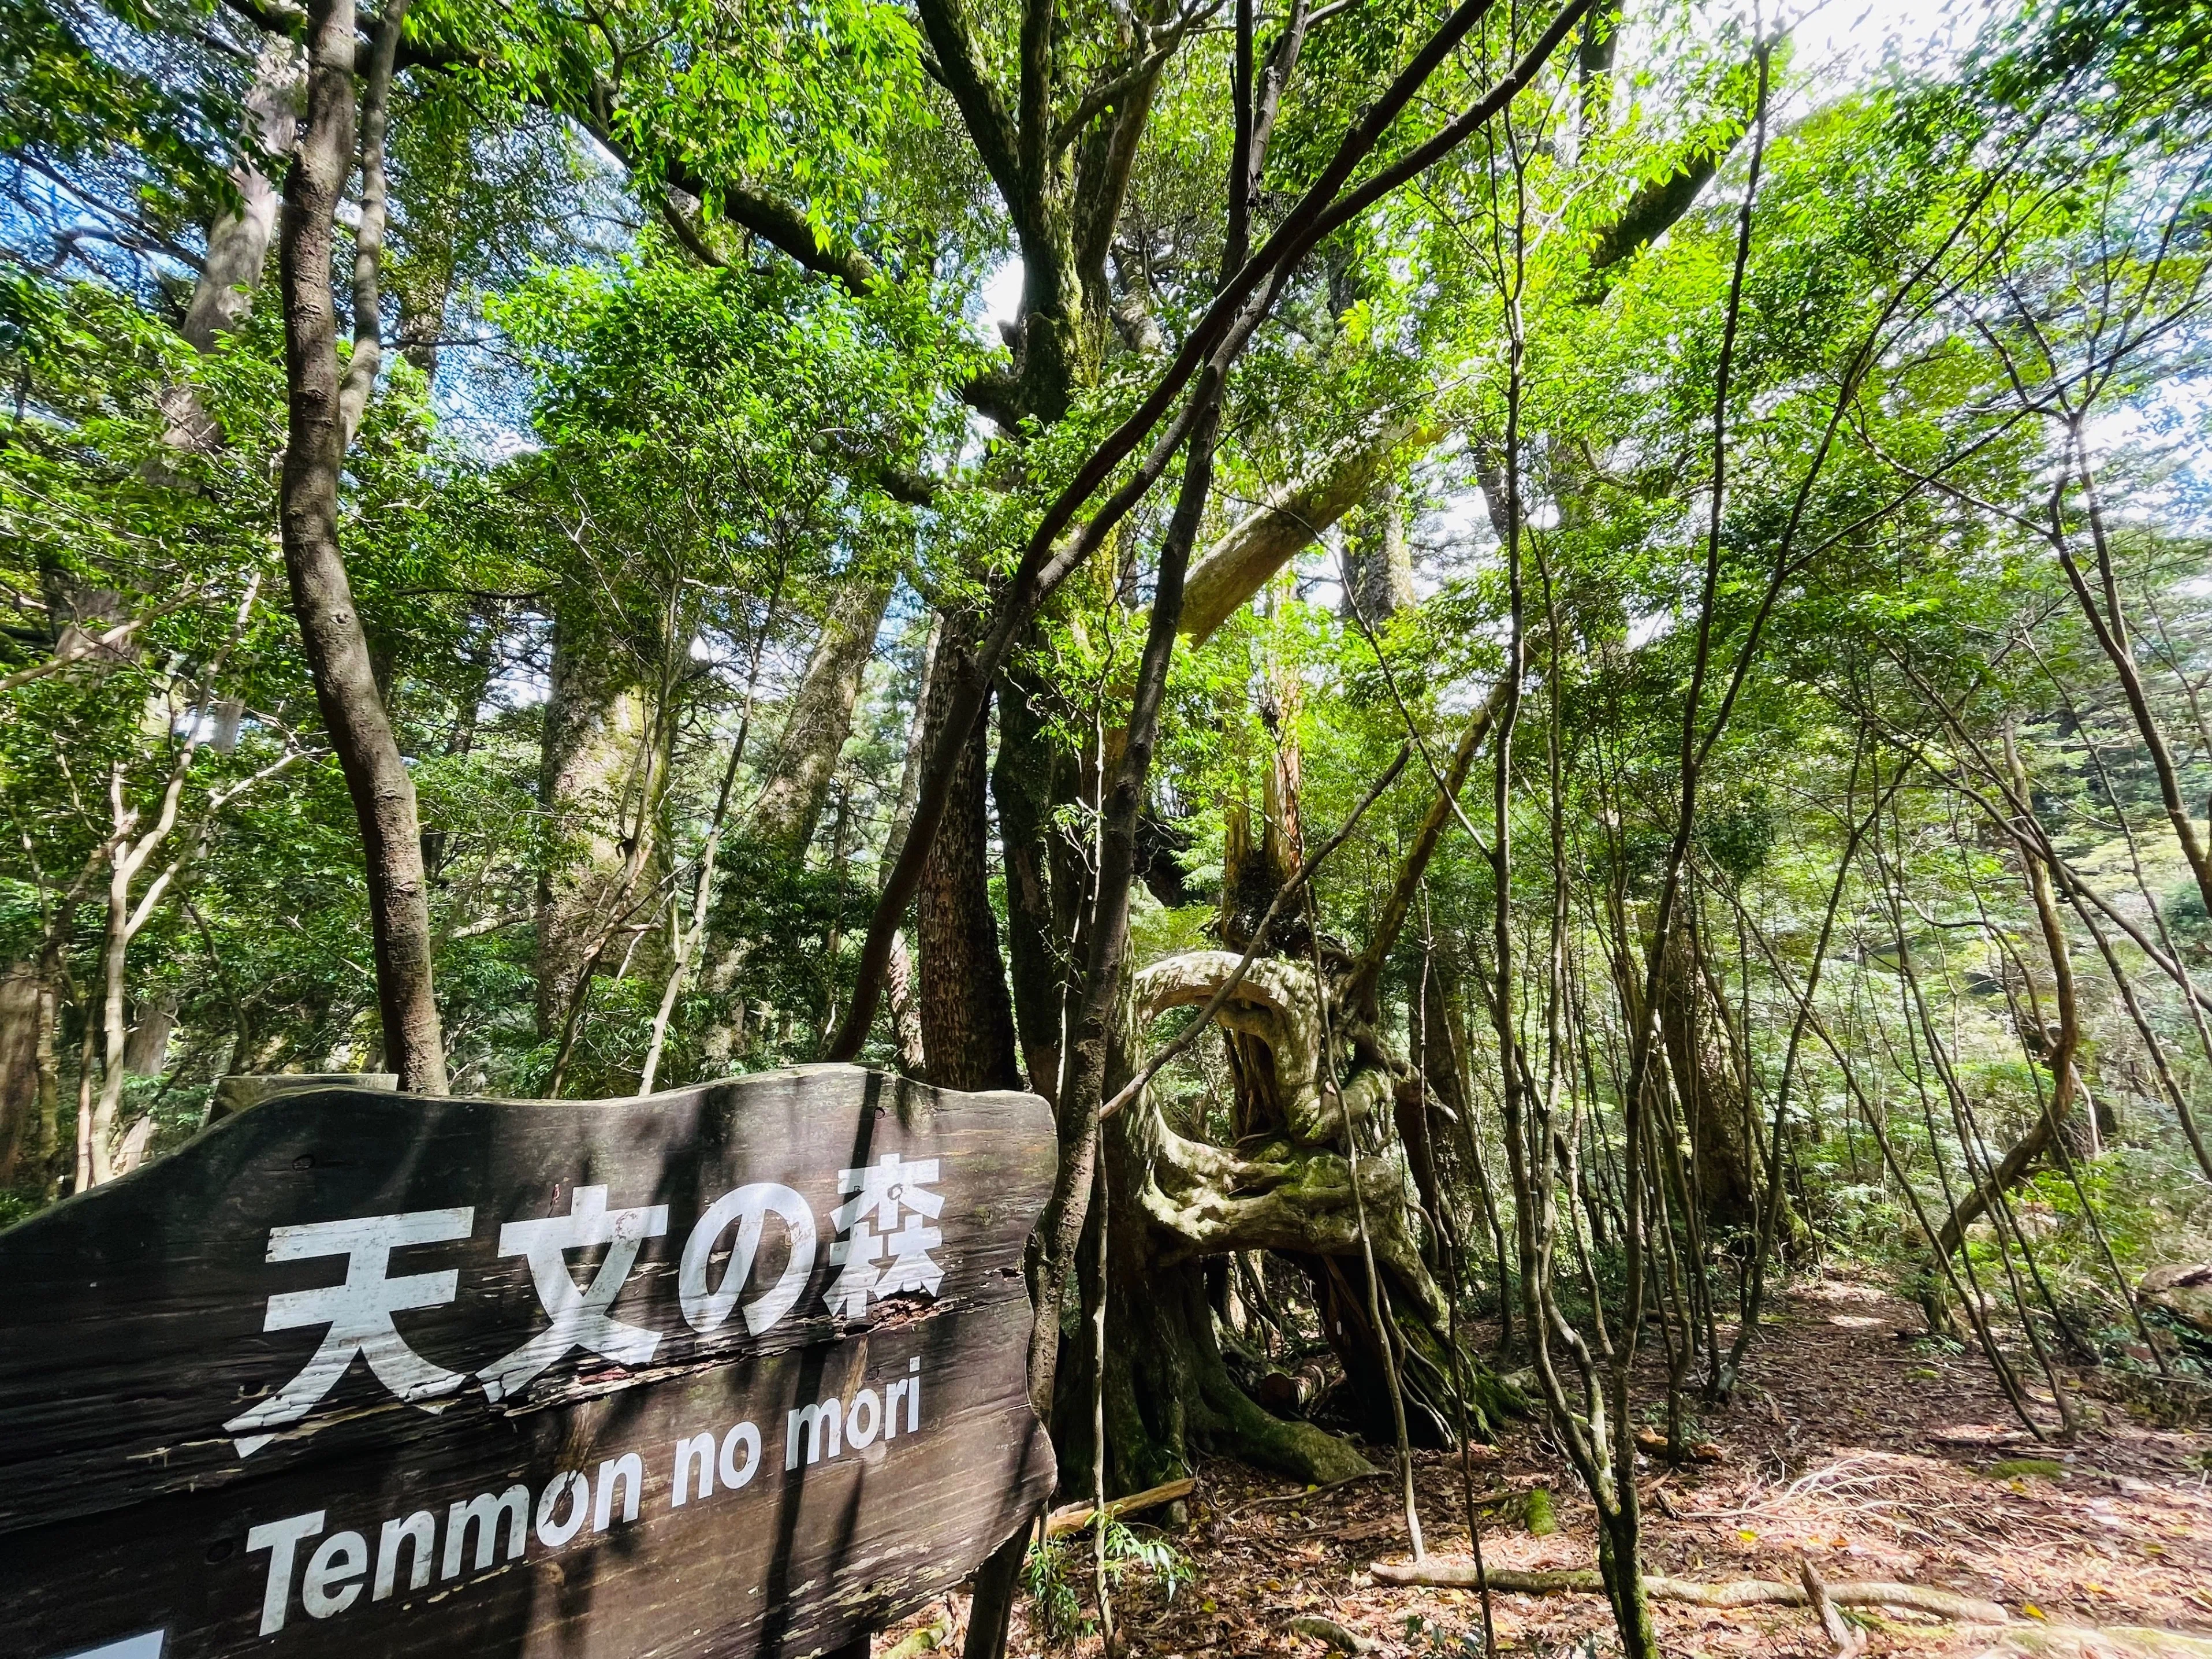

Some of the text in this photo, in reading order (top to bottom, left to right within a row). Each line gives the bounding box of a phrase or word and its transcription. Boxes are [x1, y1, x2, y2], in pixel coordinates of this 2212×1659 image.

[223, 1154, 945, 1458] 天文の森
[247, 1356, 921, 1636] Tenmon no mori
